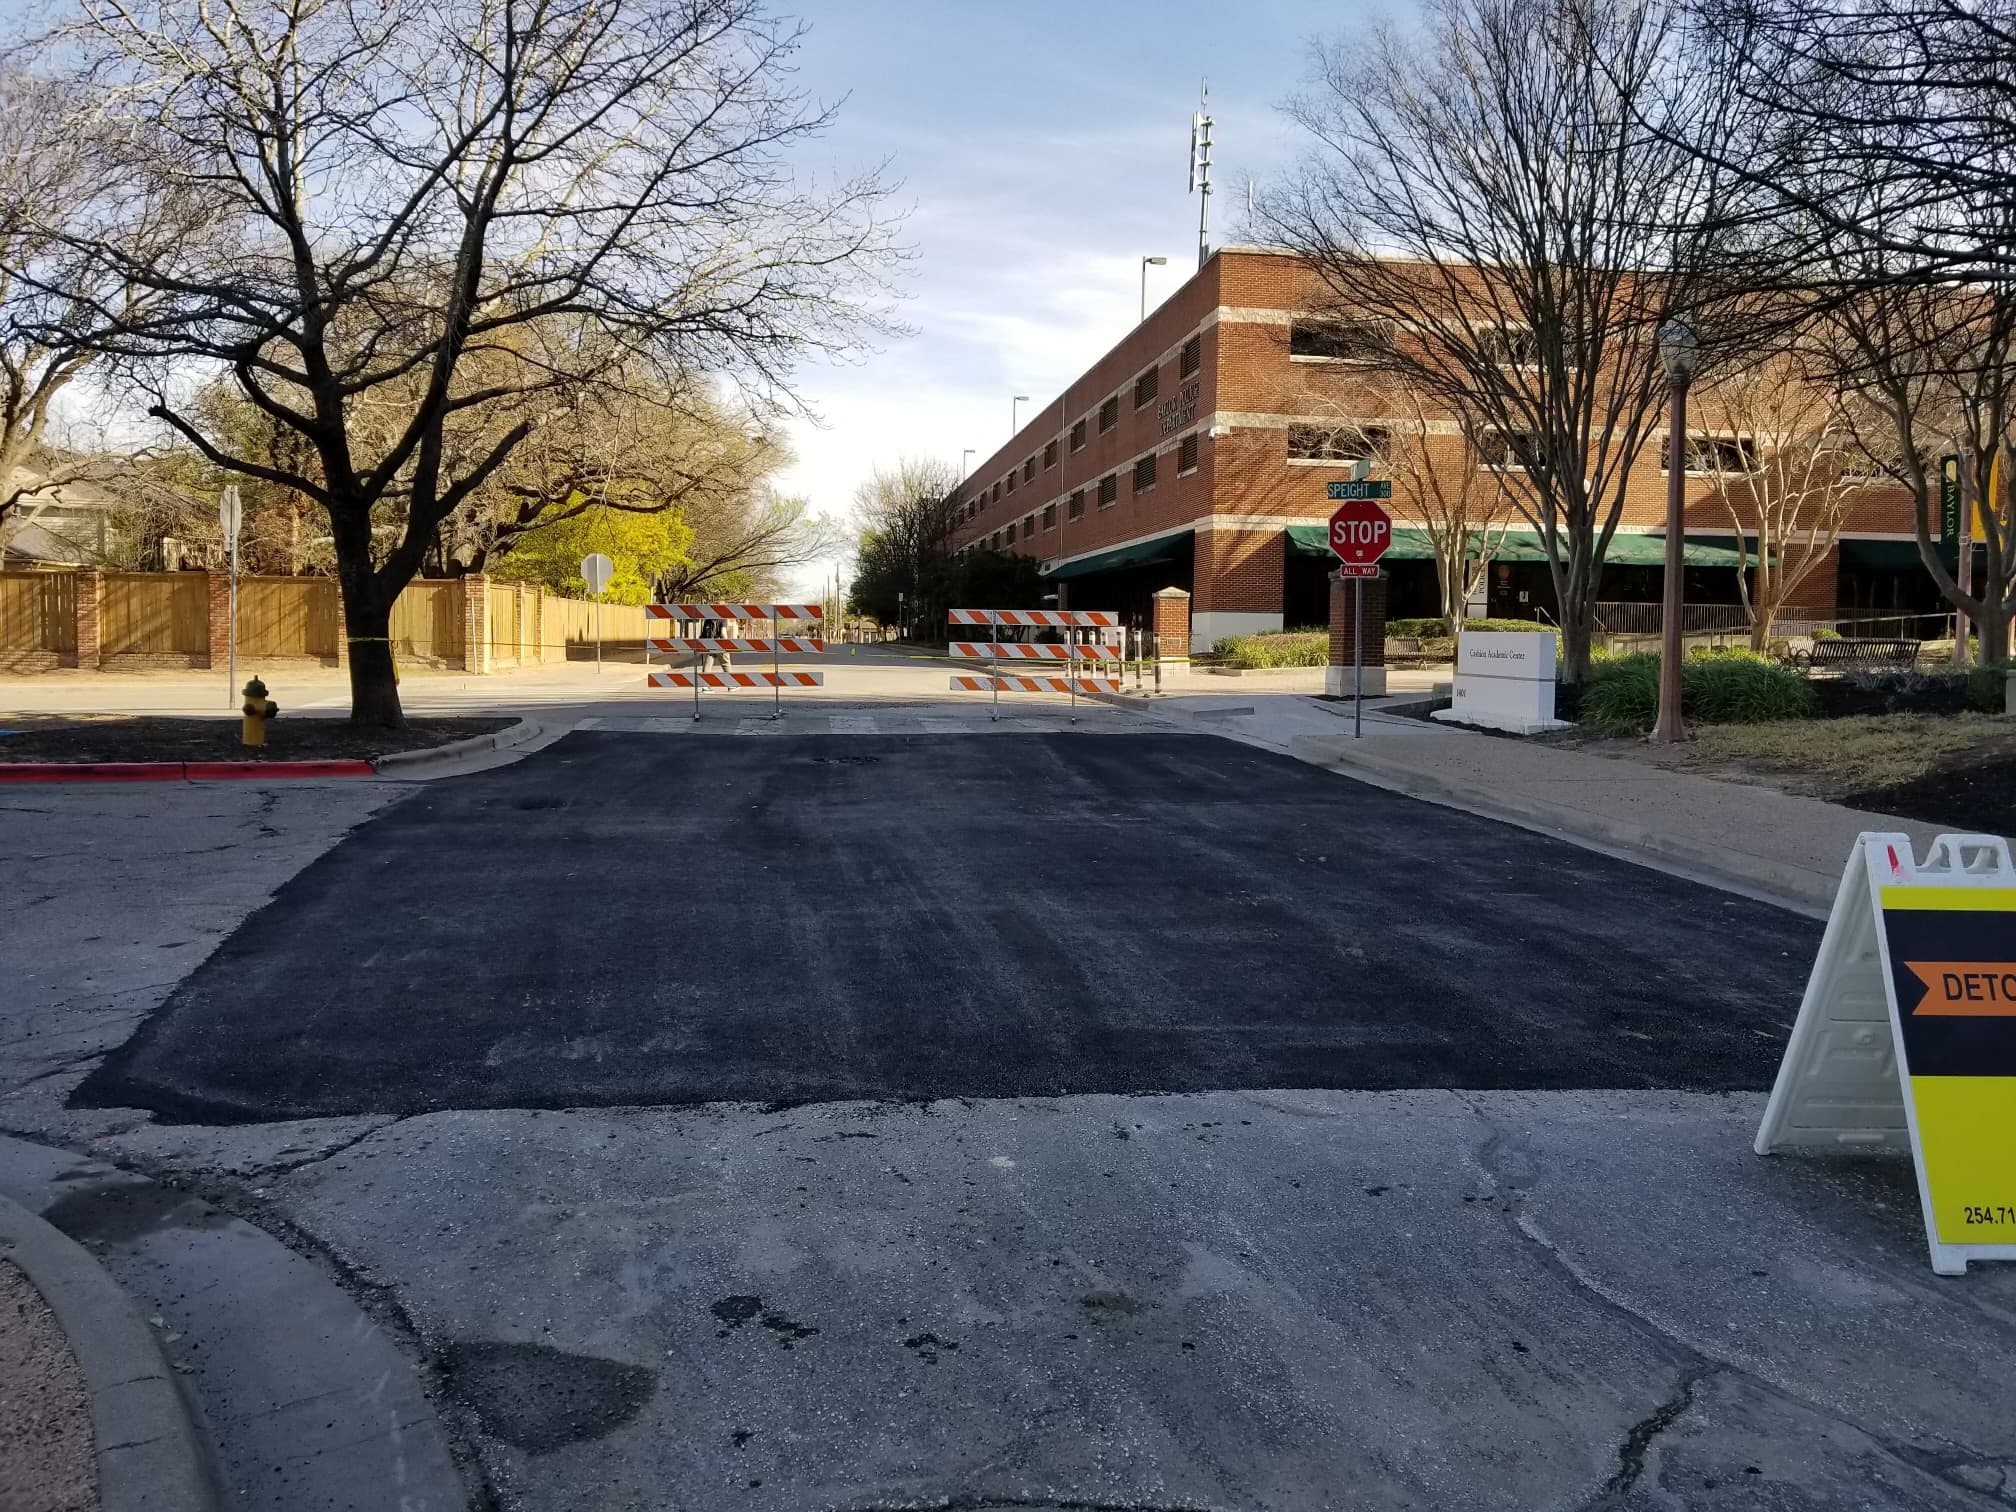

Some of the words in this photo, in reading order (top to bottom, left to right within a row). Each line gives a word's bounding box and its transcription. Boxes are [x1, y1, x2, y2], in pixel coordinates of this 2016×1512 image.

[1328, 483, 1369, 497] SPEIGHT
[1946, 485, 1955, 537] BAYLOR
[1334, 521, 1387, 544] STOP
[1343, 567, 1356, 575] ALL
[1362, 567, 1376, 575] WAY
